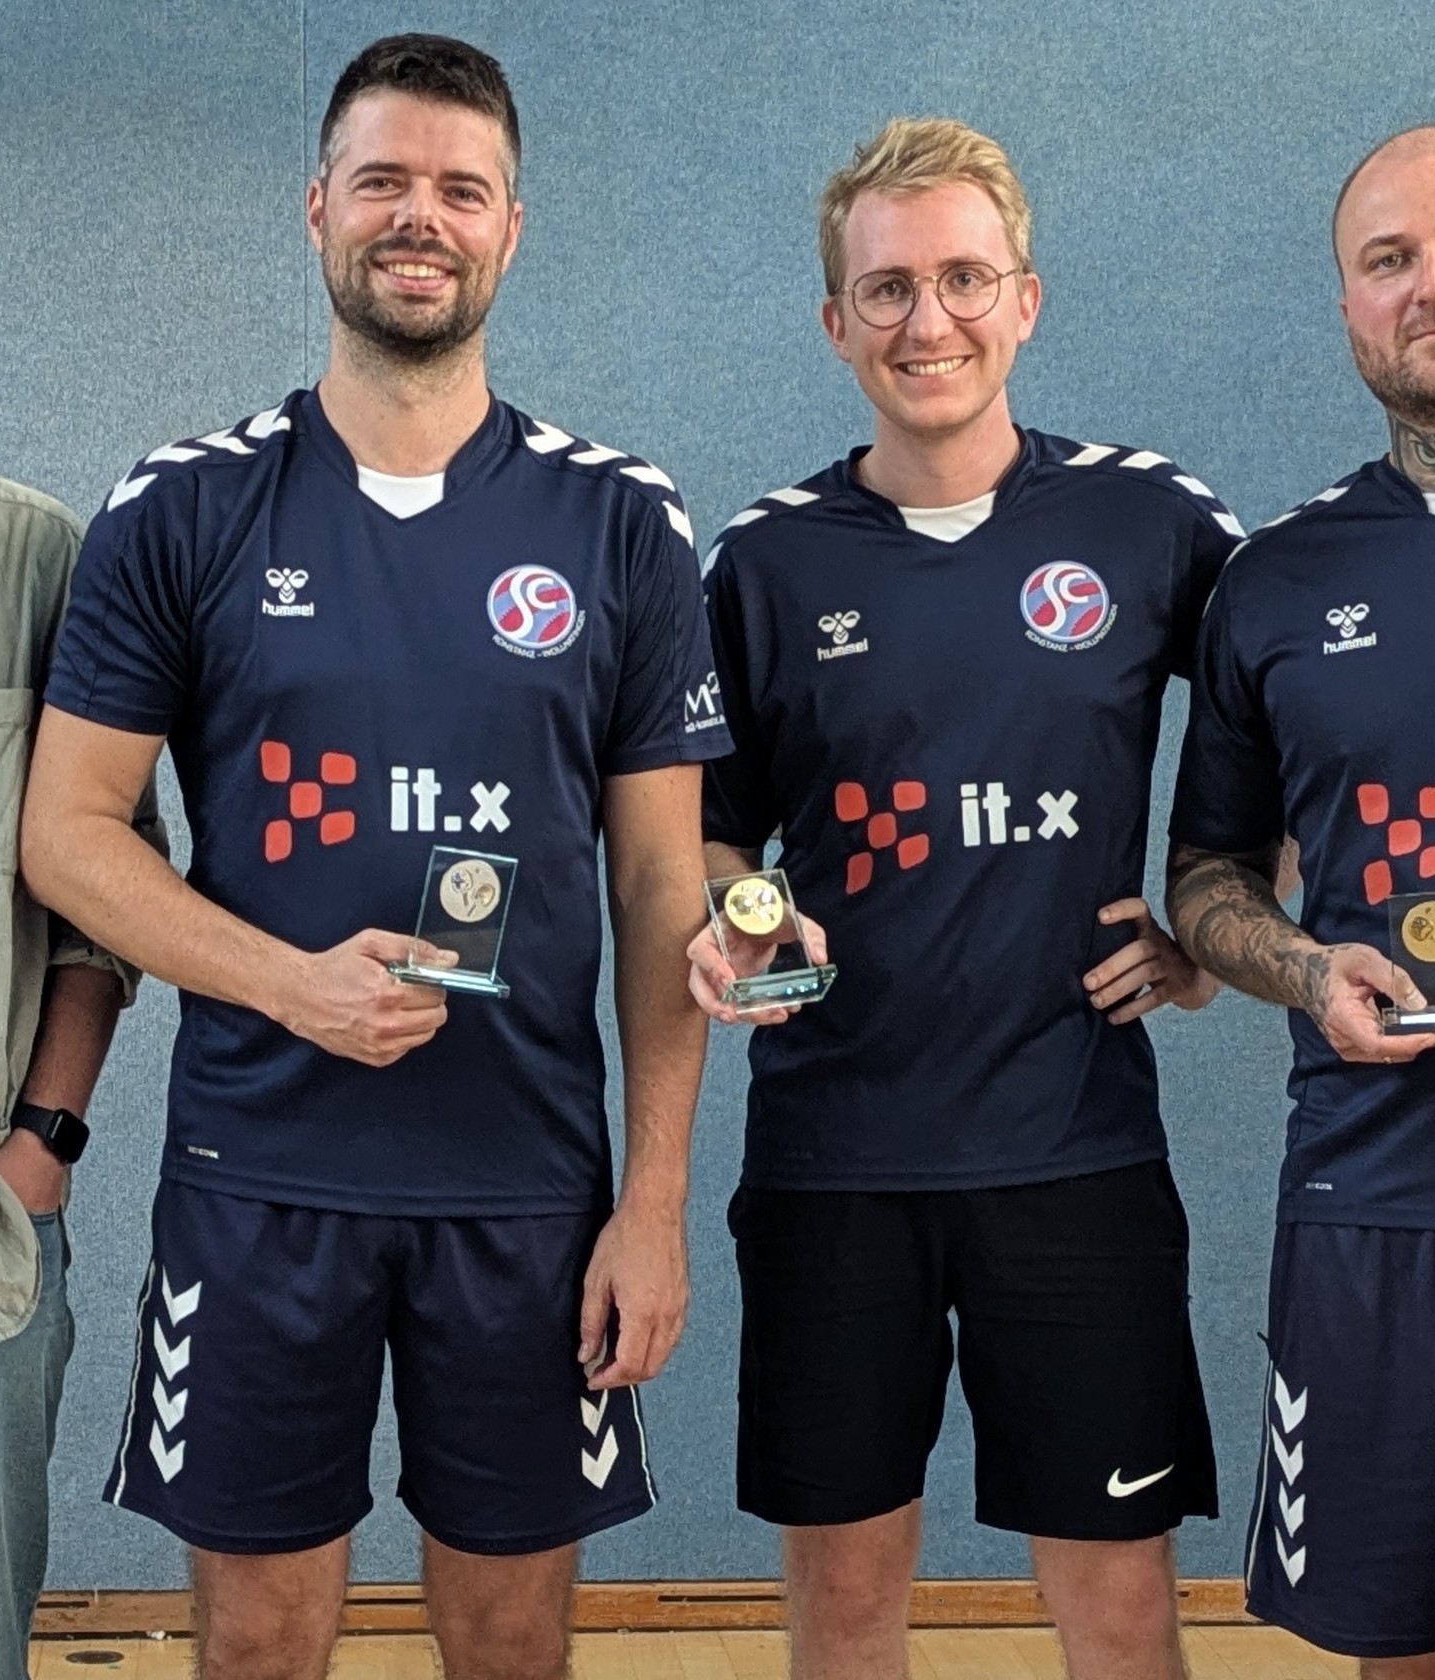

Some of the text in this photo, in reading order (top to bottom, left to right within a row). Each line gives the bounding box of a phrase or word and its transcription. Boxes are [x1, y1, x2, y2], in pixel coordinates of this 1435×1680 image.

[262, 598, 314, 617] hummel
[1323, 632, 1377, 655] hummel
[390, 766, 511, 833] it.x
[960, 781, 1080, 847] it.x
